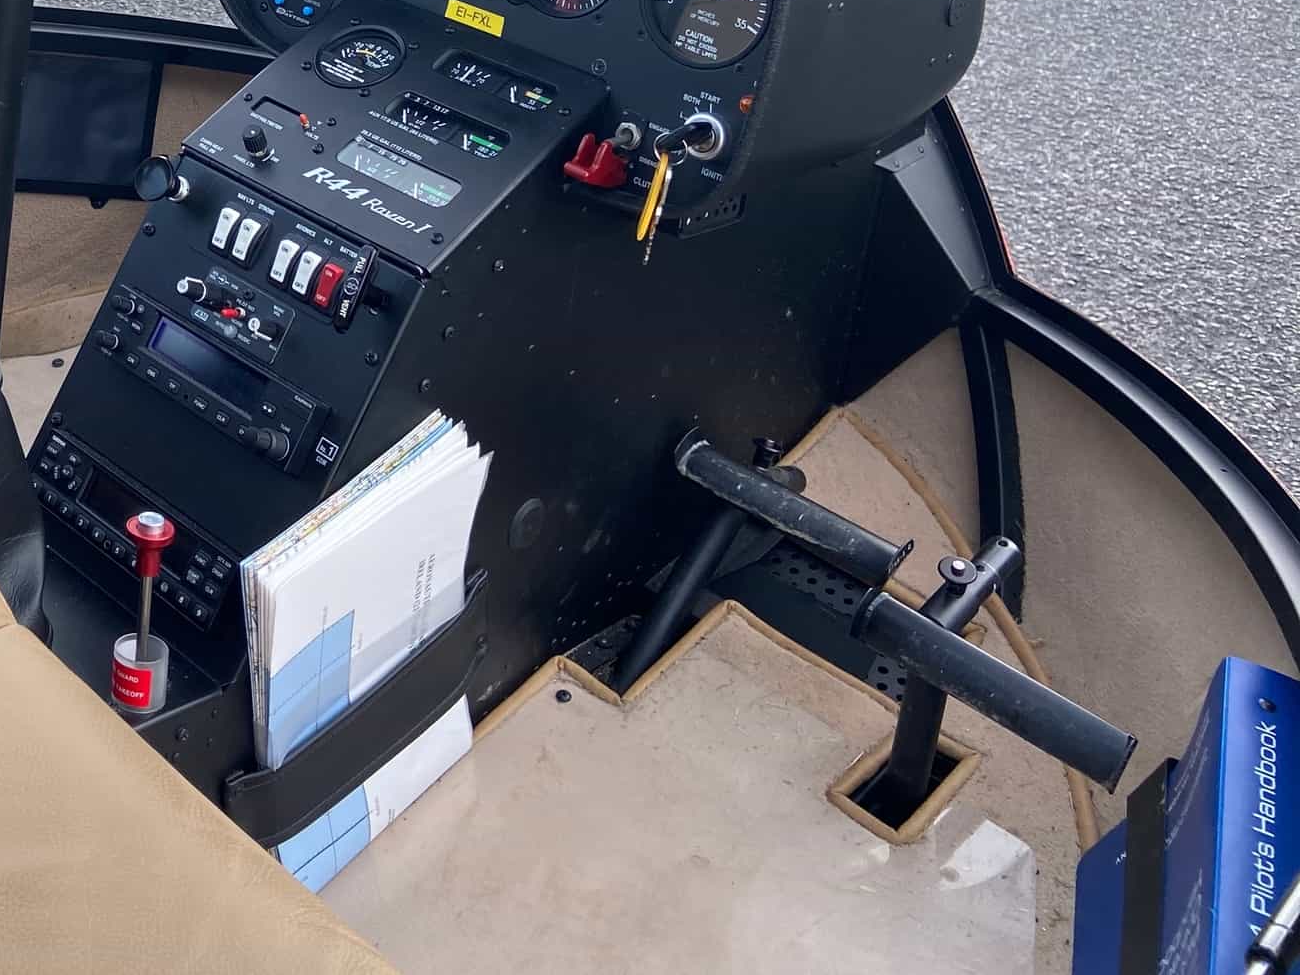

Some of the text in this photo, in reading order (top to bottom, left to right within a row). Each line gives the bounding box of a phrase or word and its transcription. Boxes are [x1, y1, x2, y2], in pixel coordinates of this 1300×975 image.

[455, 6, 492, 29] EI-FXL
[734, 18, 747, 29] 35
[685, 29, 714, 44] CAUTION
[687, 36, 698, 45] NOT
[684, 43, 700, 54] TABLE
[683, 93, 701, 106] BOTH
[700, 91, 721, 104] START
[633, 176, 652, 189] CLUT
[246, 197, 255, 206] LTS
[302, 167, 370, 200] R44
[361, 198, 416, 229] Raven
[413, 223, 434, 234] I
[258, 203, 276, 216] STROBE
[296, 223, 316, 238] AVIONICS
[324, 237, 334, 246] ALT
[340, 246, 358, 258] BATTER
[353, 256, 367, 274] PULL
[339, 299, 351, 319] VENT
[1251, 721, 1277, 837] Handbook
[1251, 841, 1276, 918] Pilot's
